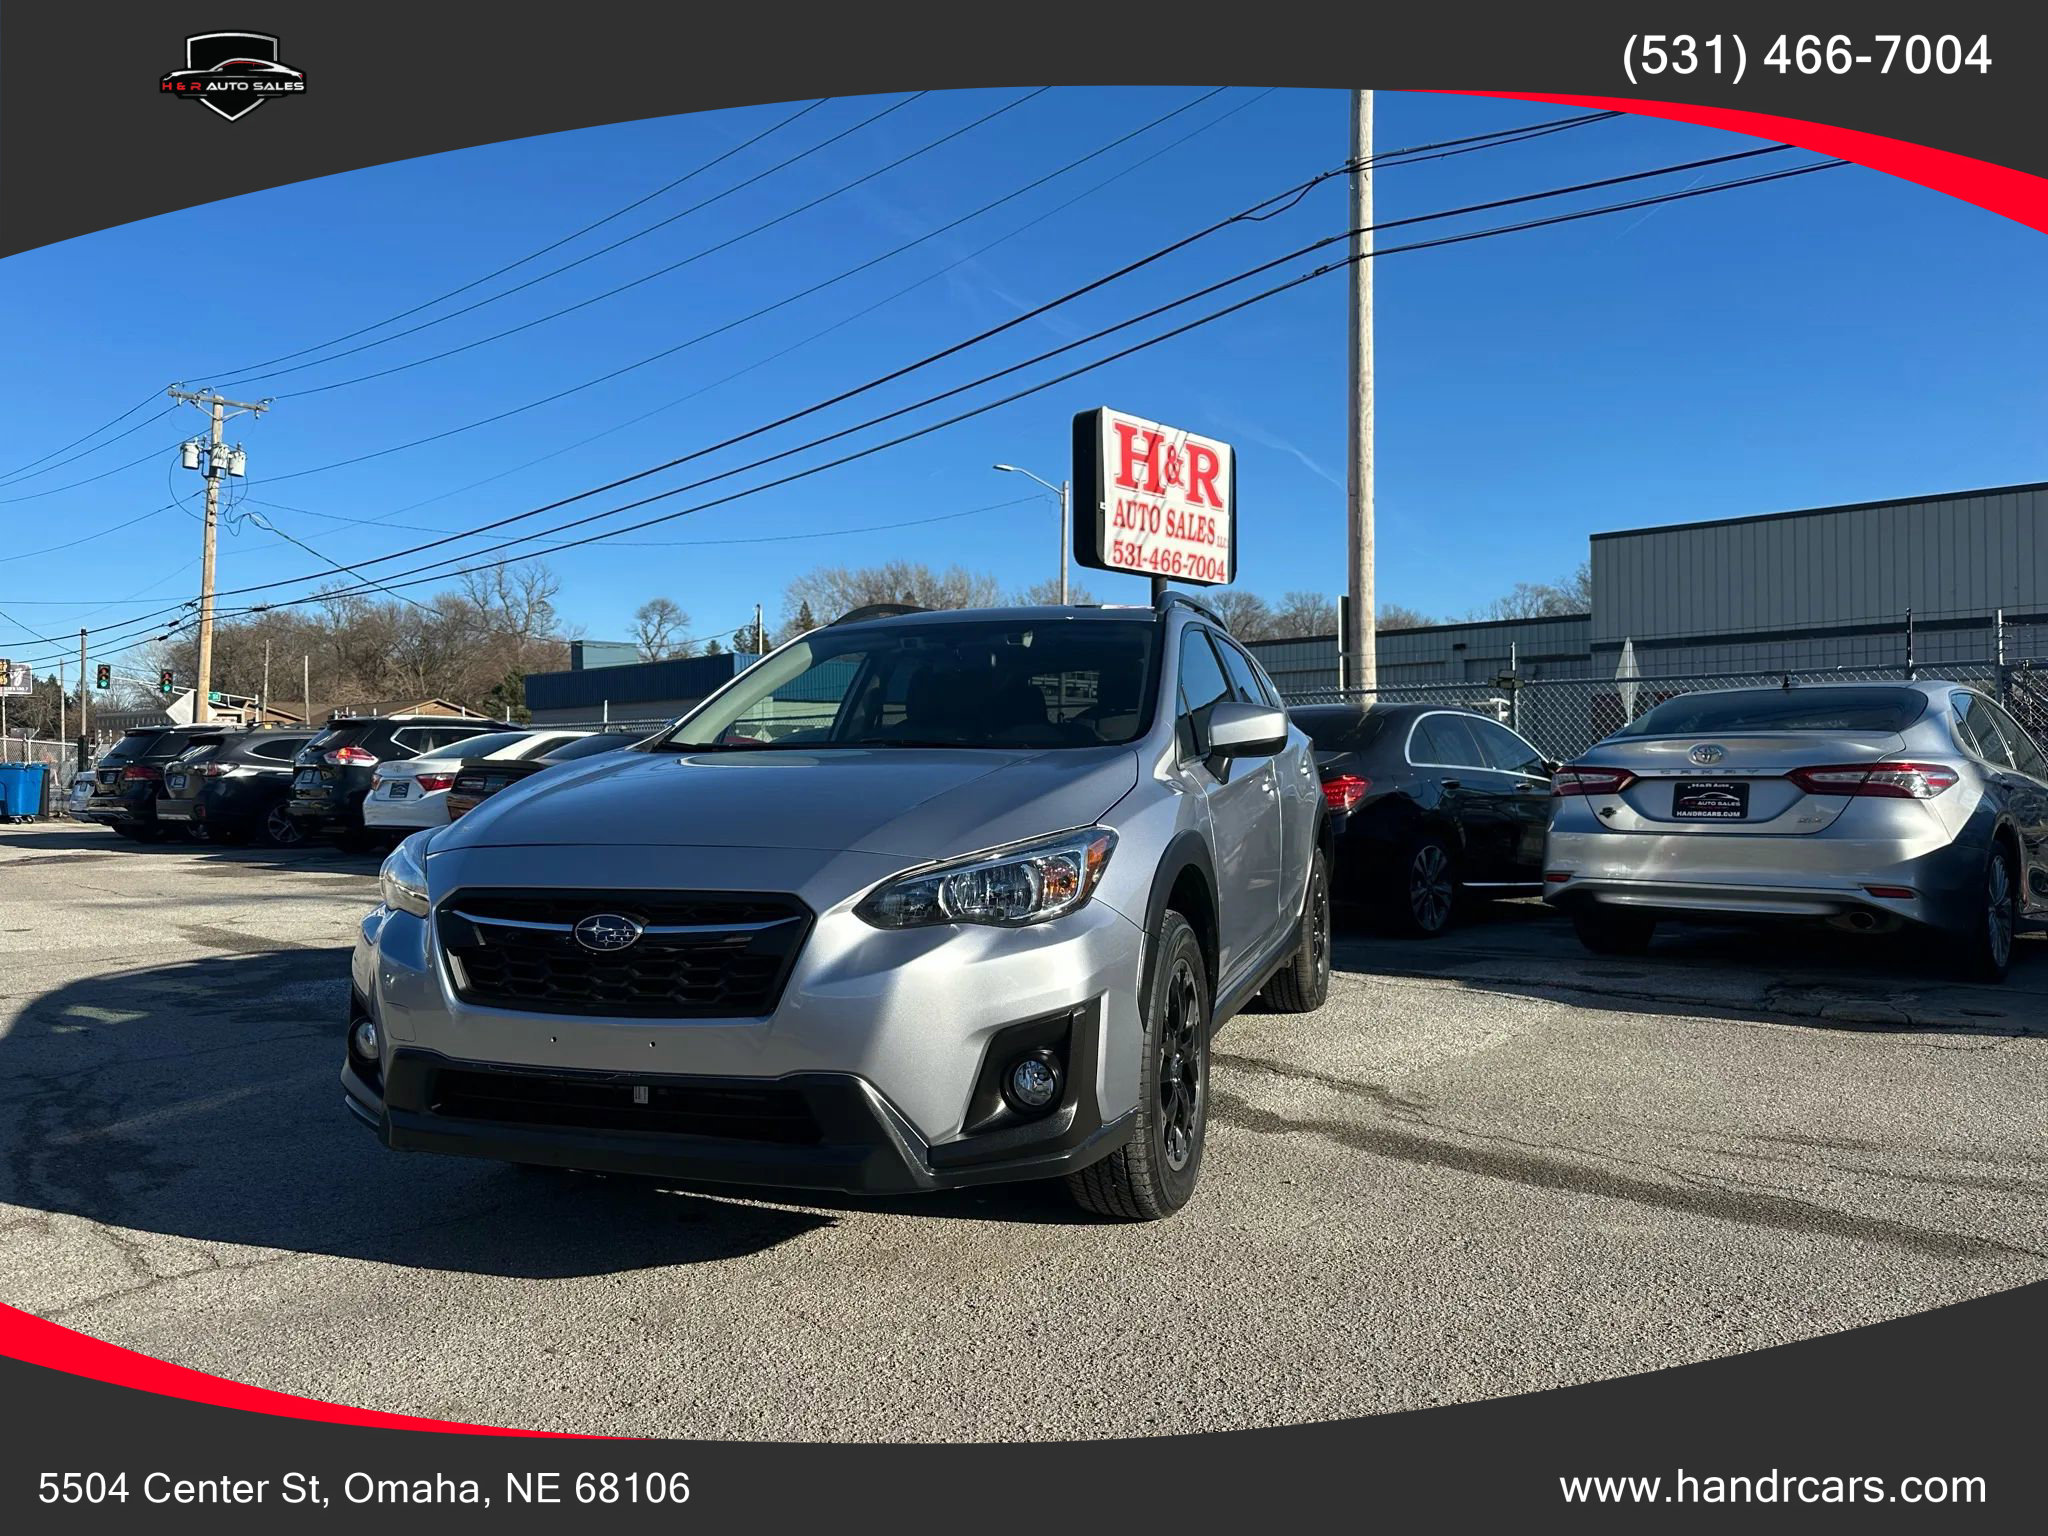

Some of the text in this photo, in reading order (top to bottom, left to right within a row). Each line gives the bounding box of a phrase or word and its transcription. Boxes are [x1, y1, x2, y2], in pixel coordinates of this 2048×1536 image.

[1113, 498, 1160, 533] AUTO
[1165, 509, 1216, 545] SALES
[1113, 540, 1226, 582] 531-466-7004
